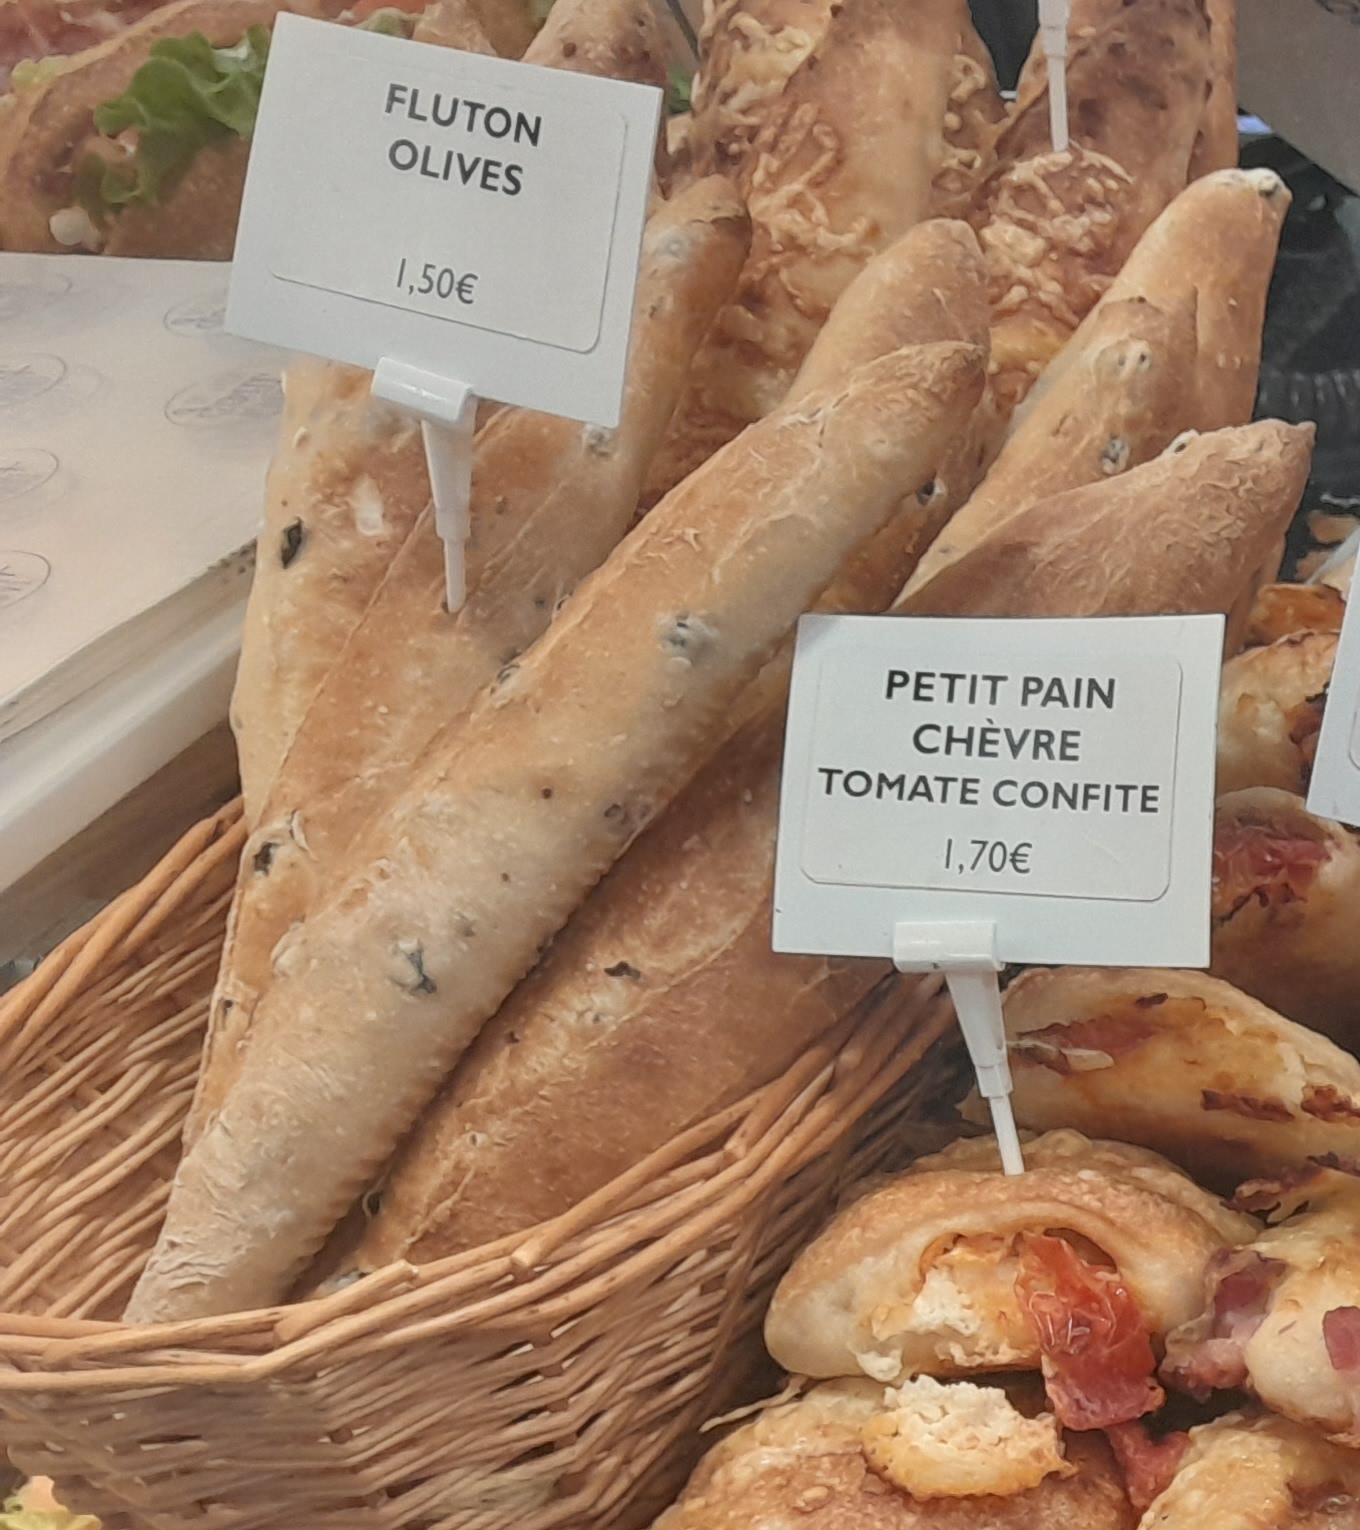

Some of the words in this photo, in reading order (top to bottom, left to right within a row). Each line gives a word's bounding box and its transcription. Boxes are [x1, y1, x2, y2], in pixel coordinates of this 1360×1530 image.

[385, 83, 542, 147] FLUTON
[388, 138, 524, 196] OLIVES
[396, 258, 479, 305] 1,50€
[885, 669, 1009, 706] PETIT
[1020, 676, 1116, 710] PAIN
[912, 718, 1081, 762] CHÈVRE
[817, 767, 981, 806] TOMATE
[992, 779, 1160, 814] CONFITE
[945, 838, 1033, 875] 1,70€
